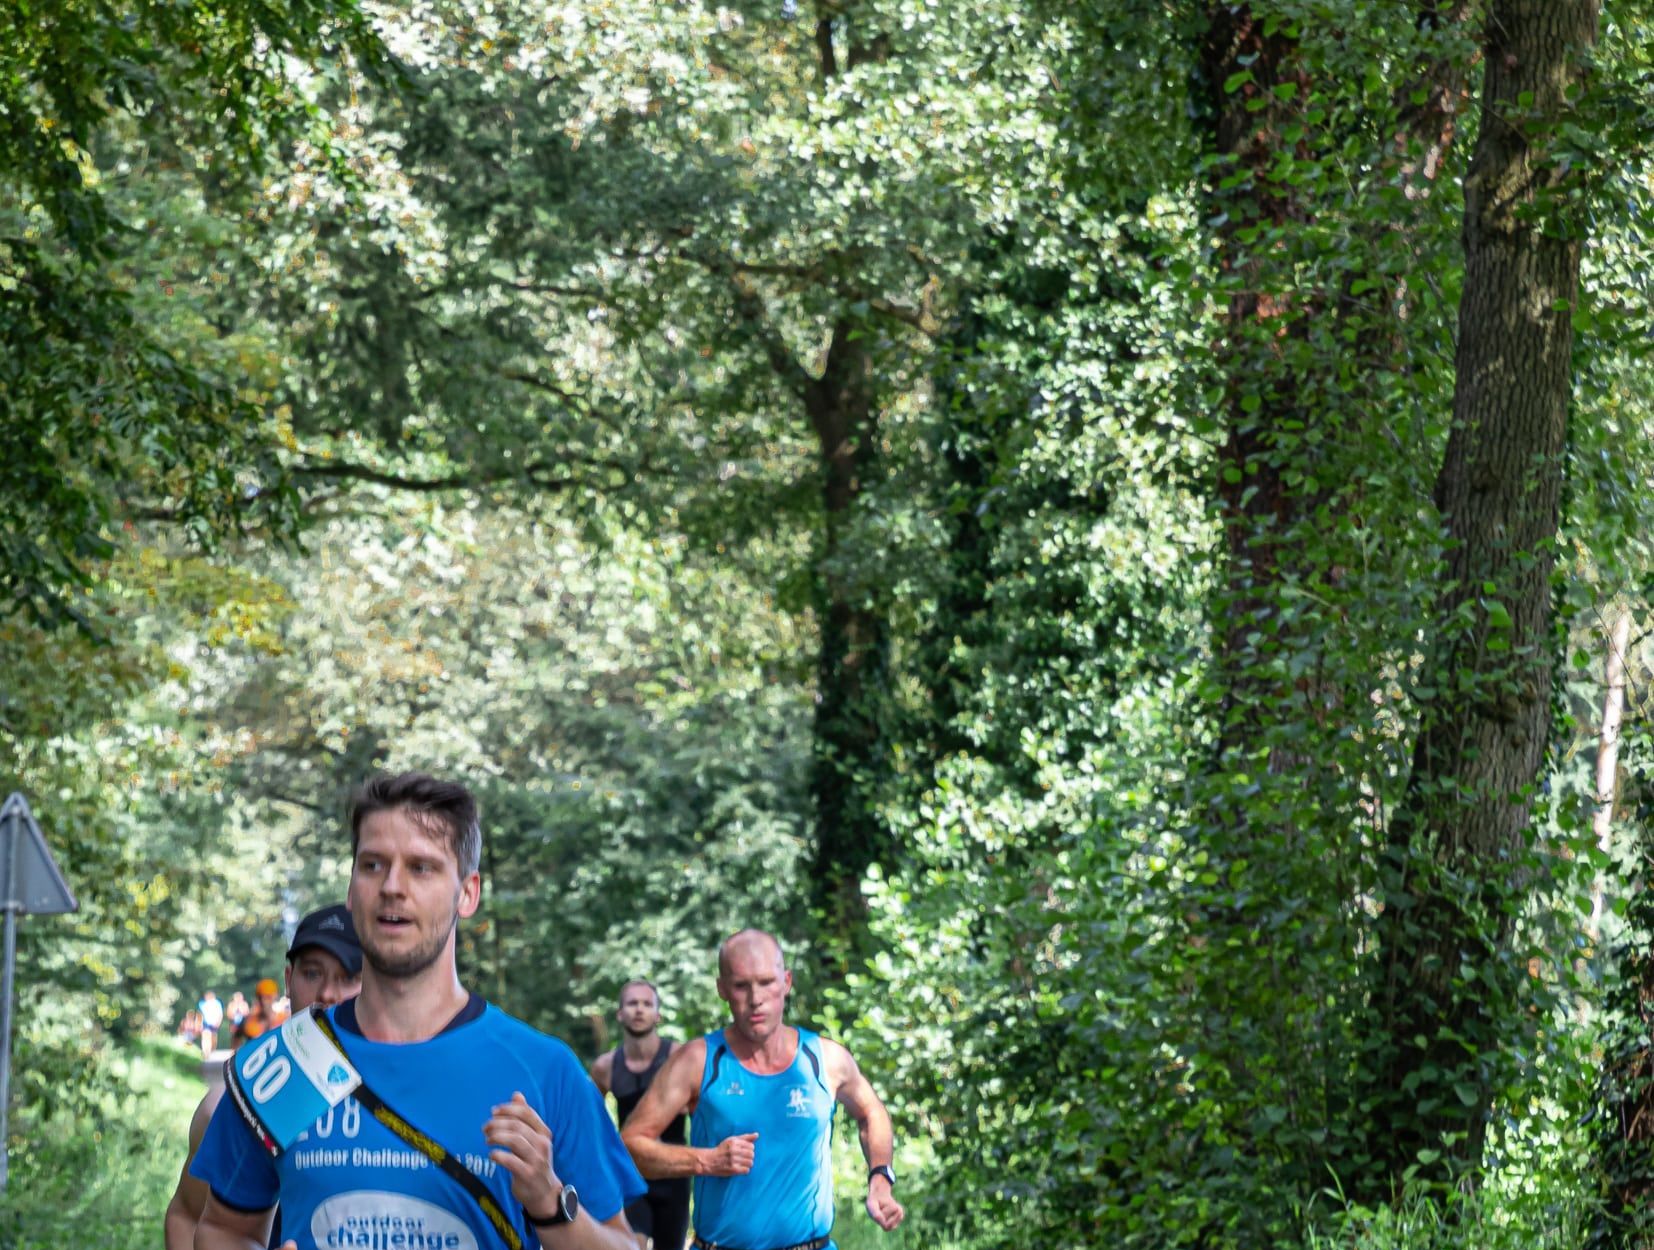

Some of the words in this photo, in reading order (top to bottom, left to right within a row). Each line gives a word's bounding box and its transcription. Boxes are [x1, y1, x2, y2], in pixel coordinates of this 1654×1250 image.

[242, 1034, 291, 1104] 60
[295, 1147, 349, 1170] Outdoor
[352, 1147, 429, 1170] Challenge
[346, 1214, 424, 1230] outdoor
